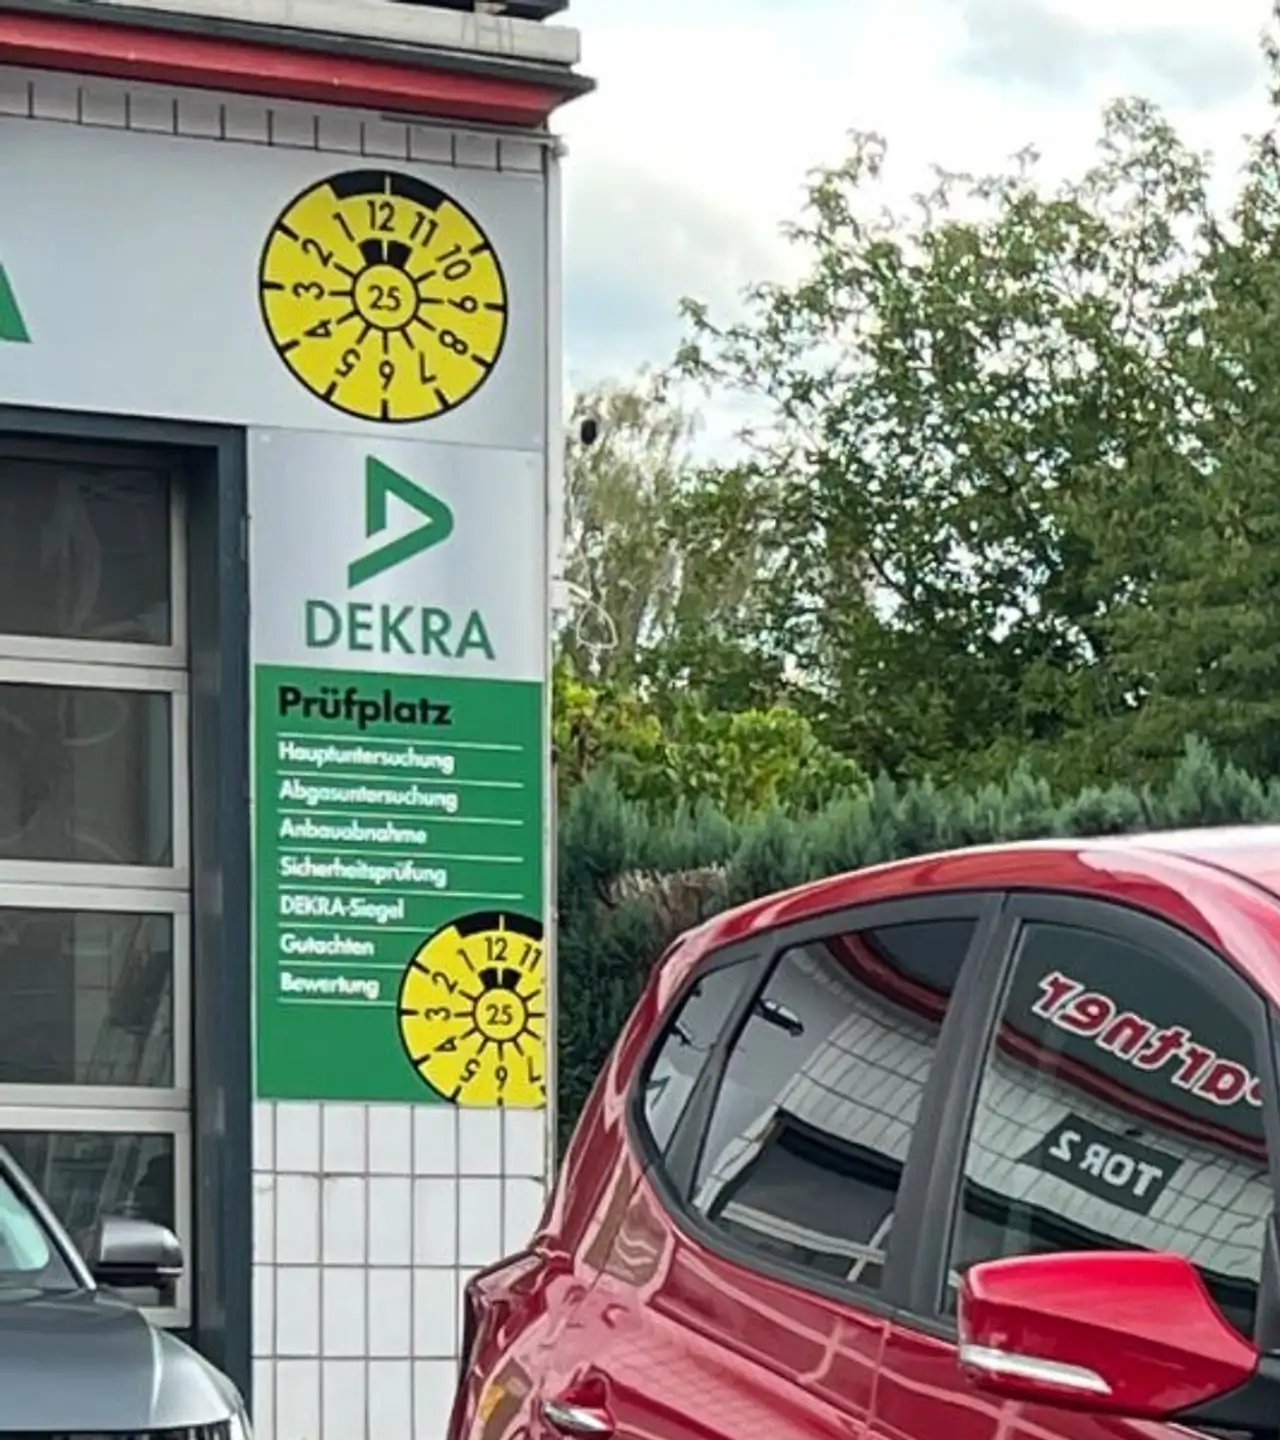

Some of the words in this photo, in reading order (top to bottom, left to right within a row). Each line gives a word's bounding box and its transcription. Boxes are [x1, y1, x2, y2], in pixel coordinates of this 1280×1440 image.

[333, 213, 355, 241] 1
[367, 201, 395, 231] 12
[410, 211, 439, 247] 11
[302, 238, 333, 267] 2
[435, 243, 472, 281] 10
[293, 282, 325, 300] 3
[368, 285, 402, 311] 25
[448, 296, 478, 313] 9
[304, 319, 331, 338] 4
[439, 330, 469, 355] 8
[335, 348, 361, 378] 5
[419, 352, 436, 384] 7
[306, 599, 496, 660] DEKRA
[278, 686, 452, 730] Prüfplatz
[278, 740, 455, 775] Hauptuntersuchung
[279, 778, 458, 813] Abgasuntersuchung
[279, 817, 427, 844] Anbauabnahme
[279, 856, 447, 888] Sicherheitsprüfung
[280, 895, 405, 924] DEKRA-Siegel
[280, 933, 374, 956] Gutachten
[485, 937, 508, 961] 12
[519, 943, 543, 972] 11
[457, 948, 475, 972] 1
[280, 972, 380, 1000] Bewertung
[431, 971, 458, 995] 2
[424, 1007, 451, 1021] 3
[485, 1004, 513, 1025] 25
[433, 1037, 457, 1052] 4
[460, 1059, 481, 1083] 5
